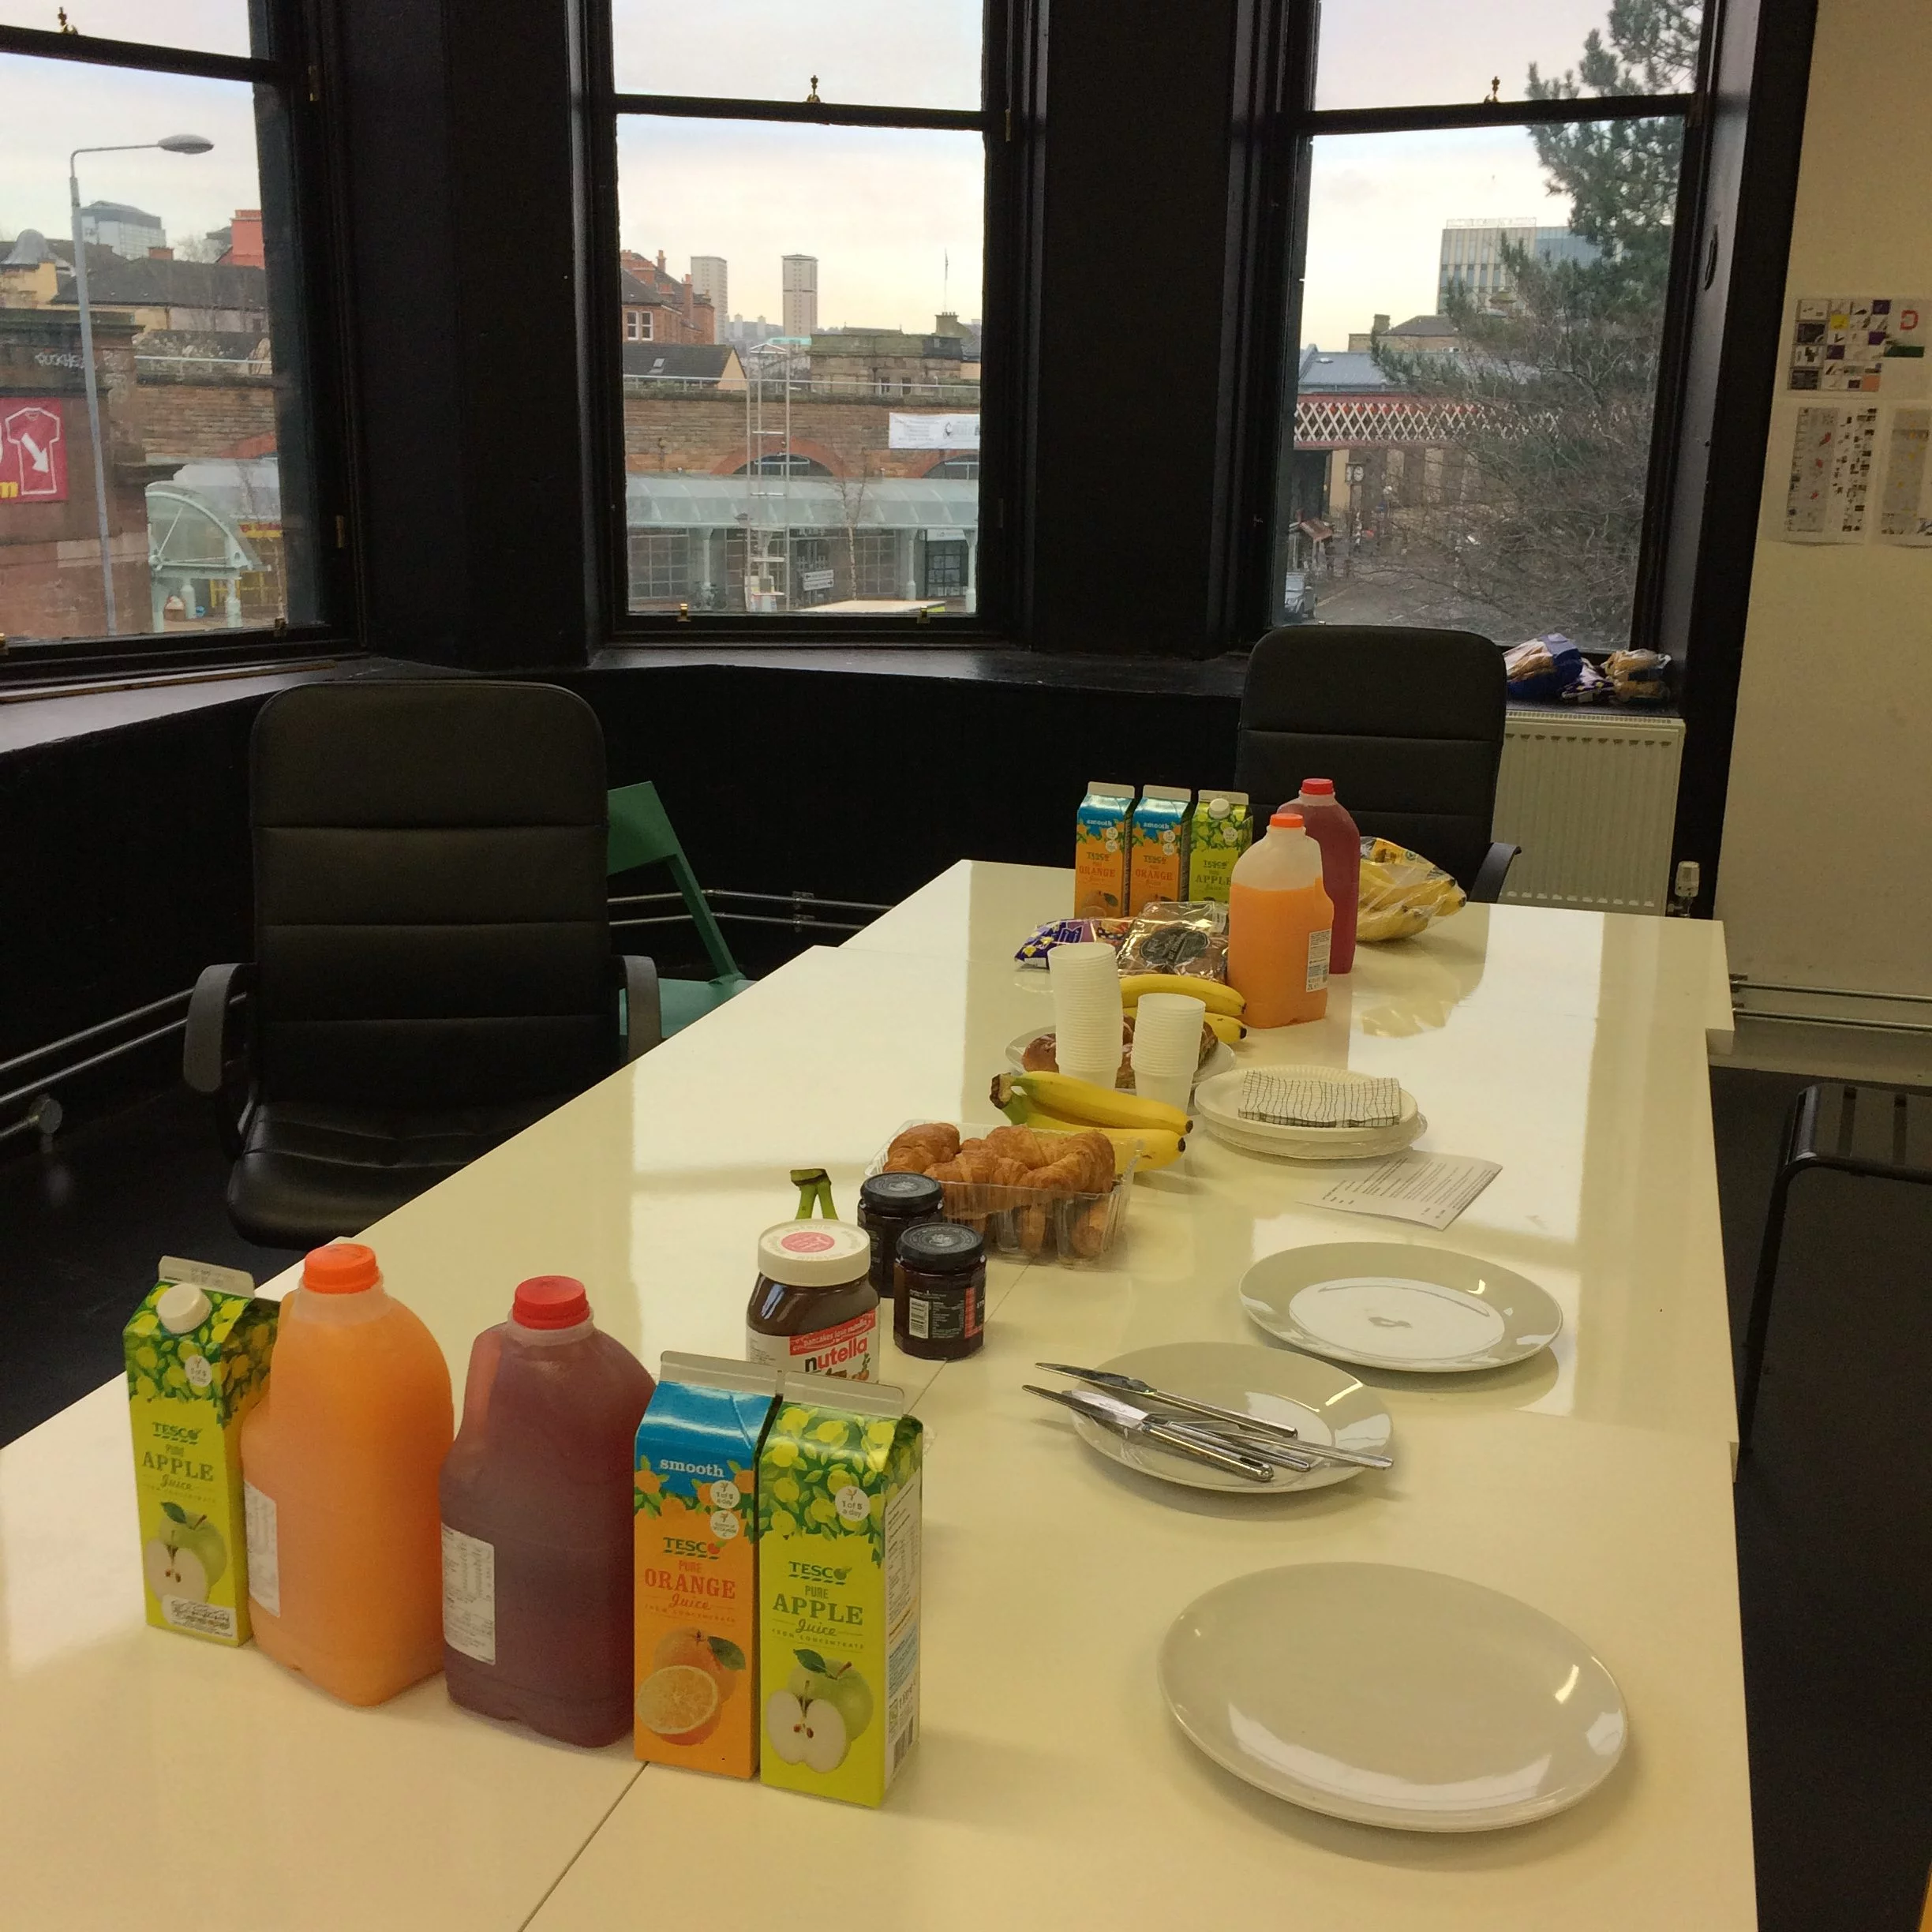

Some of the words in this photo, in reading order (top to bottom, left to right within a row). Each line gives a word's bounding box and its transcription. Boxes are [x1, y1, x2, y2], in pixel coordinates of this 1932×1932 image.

[1079, 865, 1116, 878] ORANGE
[1136, 868, 1174, 881] ORANGE
[1195, 874, 1231, 885] APPLE
[805, 1337, 867, 1372] nutella
[152, 1421, 199, 1440] TESCO
[142, 1451, 214, 1481] APPLE
[660, 1458, 724, 1477] smooth
[160, 1473, 193, 1489] Juice
[848, 1509, 861, 1518] day
[663, 1537, 720, 1555] TESCO
[679, 1560, 702, 1573] PURE
[788, 1561, 848, 1580] TESCO
[644, 1568, 736, 1599] ORANGE
[805, 1586, 829, 1599] PURE
[668, 1593, 710, 1610] Juice
[772, 1593, 863, 1626] APPLE
[796, 1619, 837, 1637] Juice
[772, 1628, 794, 1638] FROM
[799, 1634, 864, 1649] CONCENTRATE
